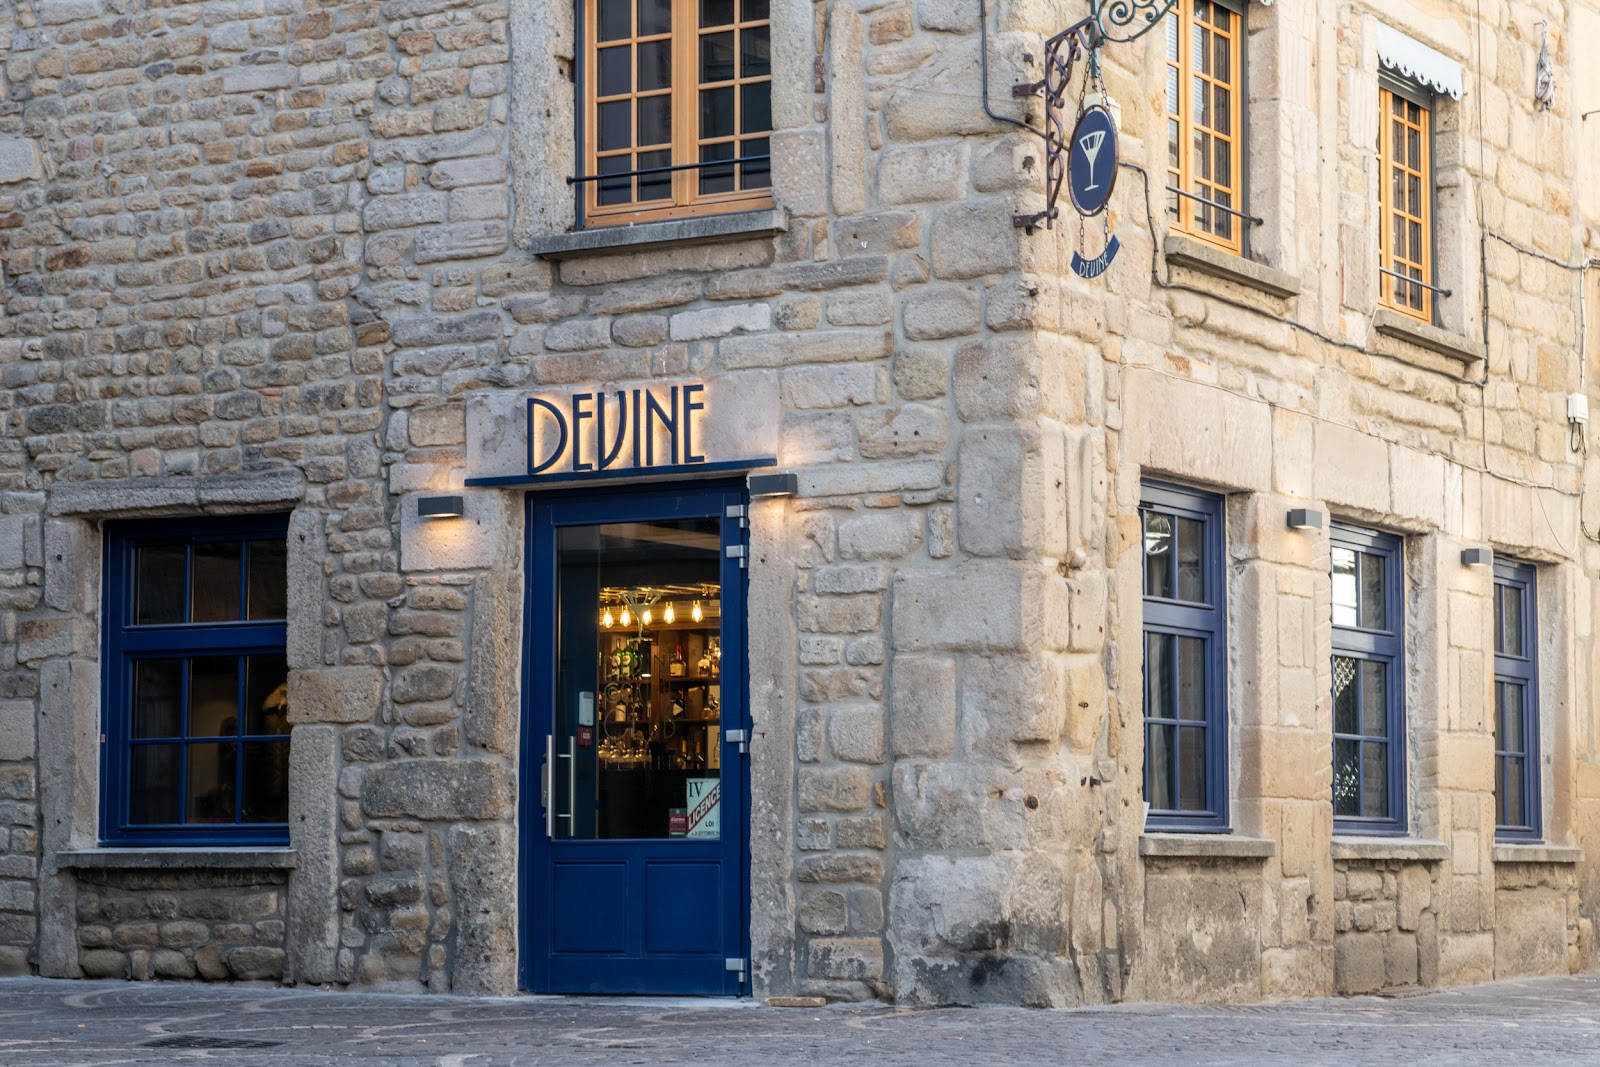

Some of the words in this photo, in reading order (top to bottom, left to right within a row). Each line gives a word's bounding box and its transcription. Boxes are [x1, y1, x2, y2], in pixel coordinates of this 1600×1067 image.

[1079, 252, 1109, 278] DEVINE
[527, 384, 705, 474] DEVINE
[688, 781, 704, 798] IV
[688, 784, 720, 830] LICENCE
